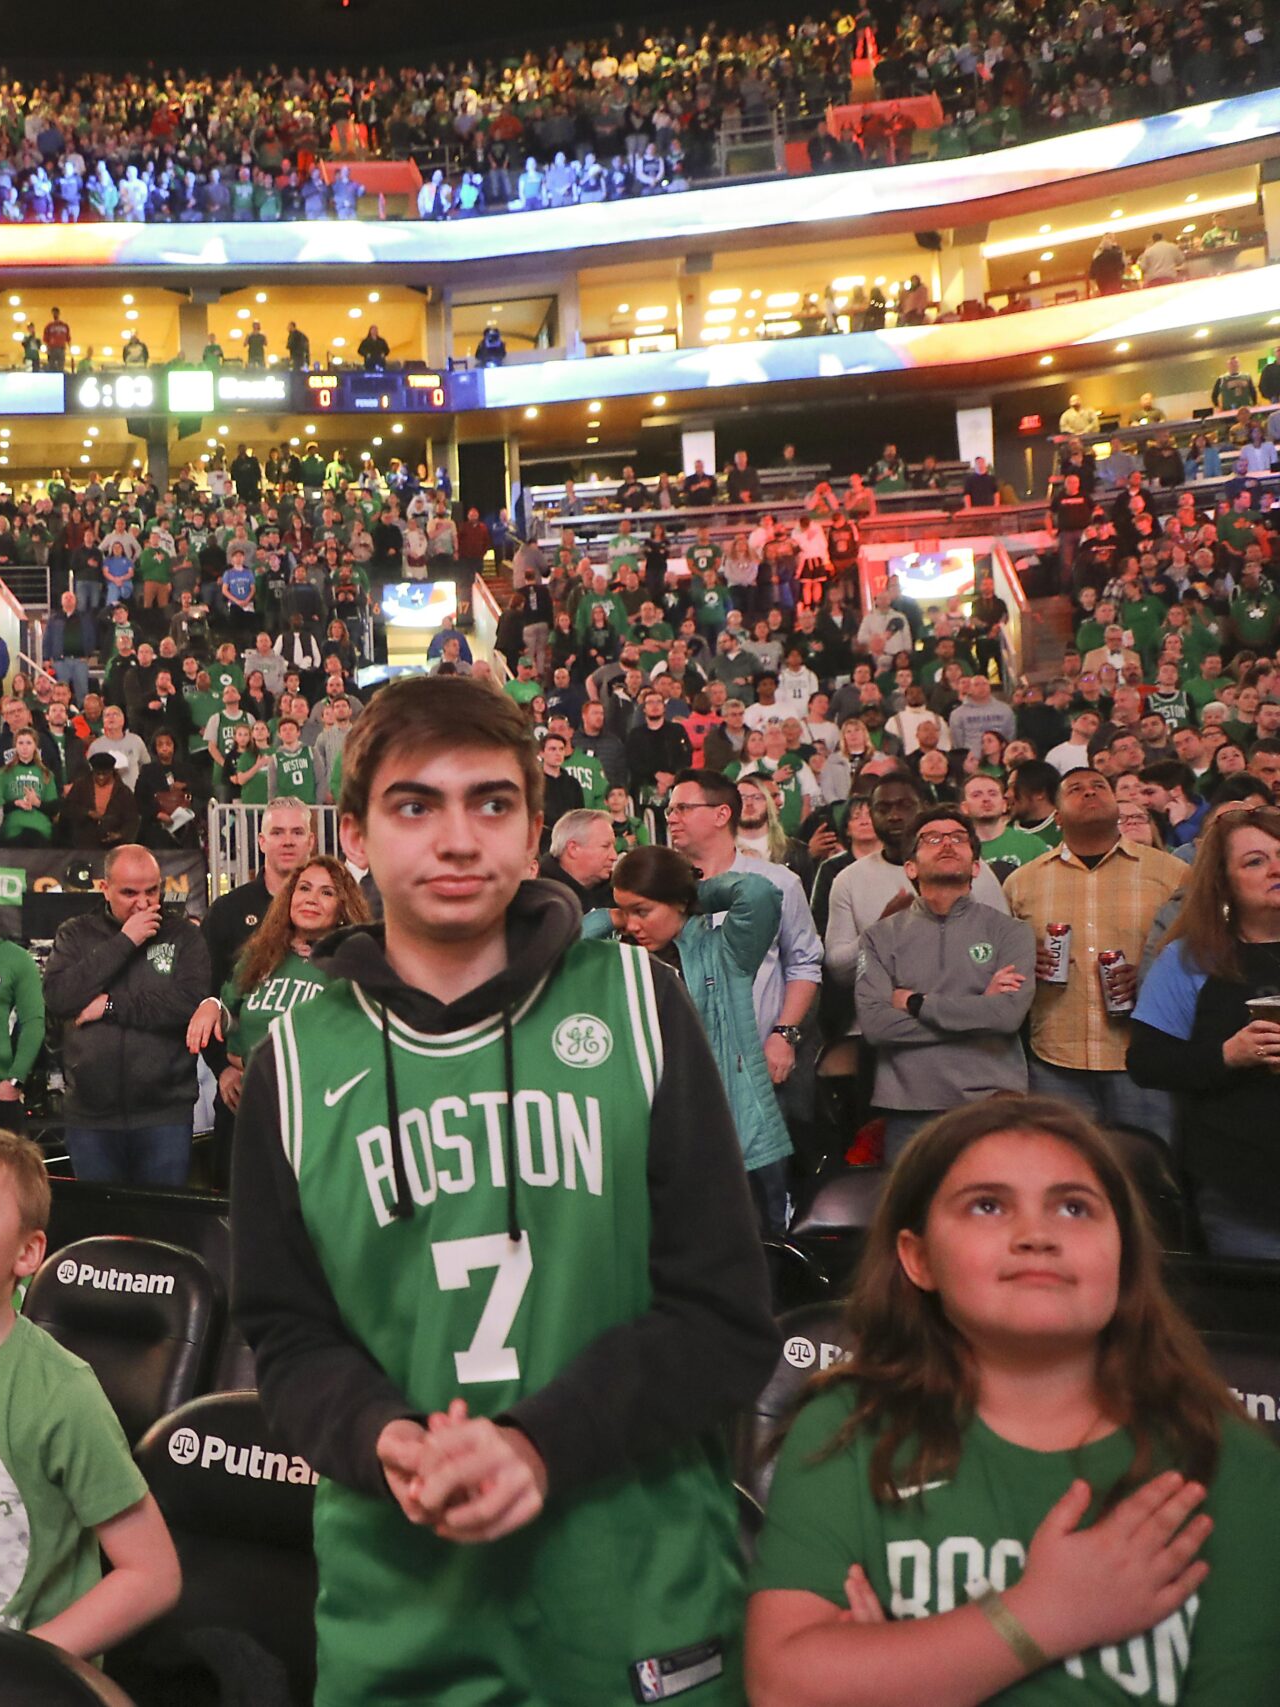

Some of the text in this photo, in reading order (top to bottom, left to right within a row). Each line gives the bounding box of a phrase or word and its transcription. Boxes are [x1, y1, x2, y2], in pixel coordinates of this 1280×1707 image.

[283, 757, 308, 773] BOSTON
[292, 771, 304, 785] 0
[565, 765, 593, 790] TICS
[246, 977, 325, 1012] CELTI
[356, 1089, 603, 1228] BOSTON
[77, 1264, 175, 1295] Putnam
[431, 1230, 533, 1384] 7
